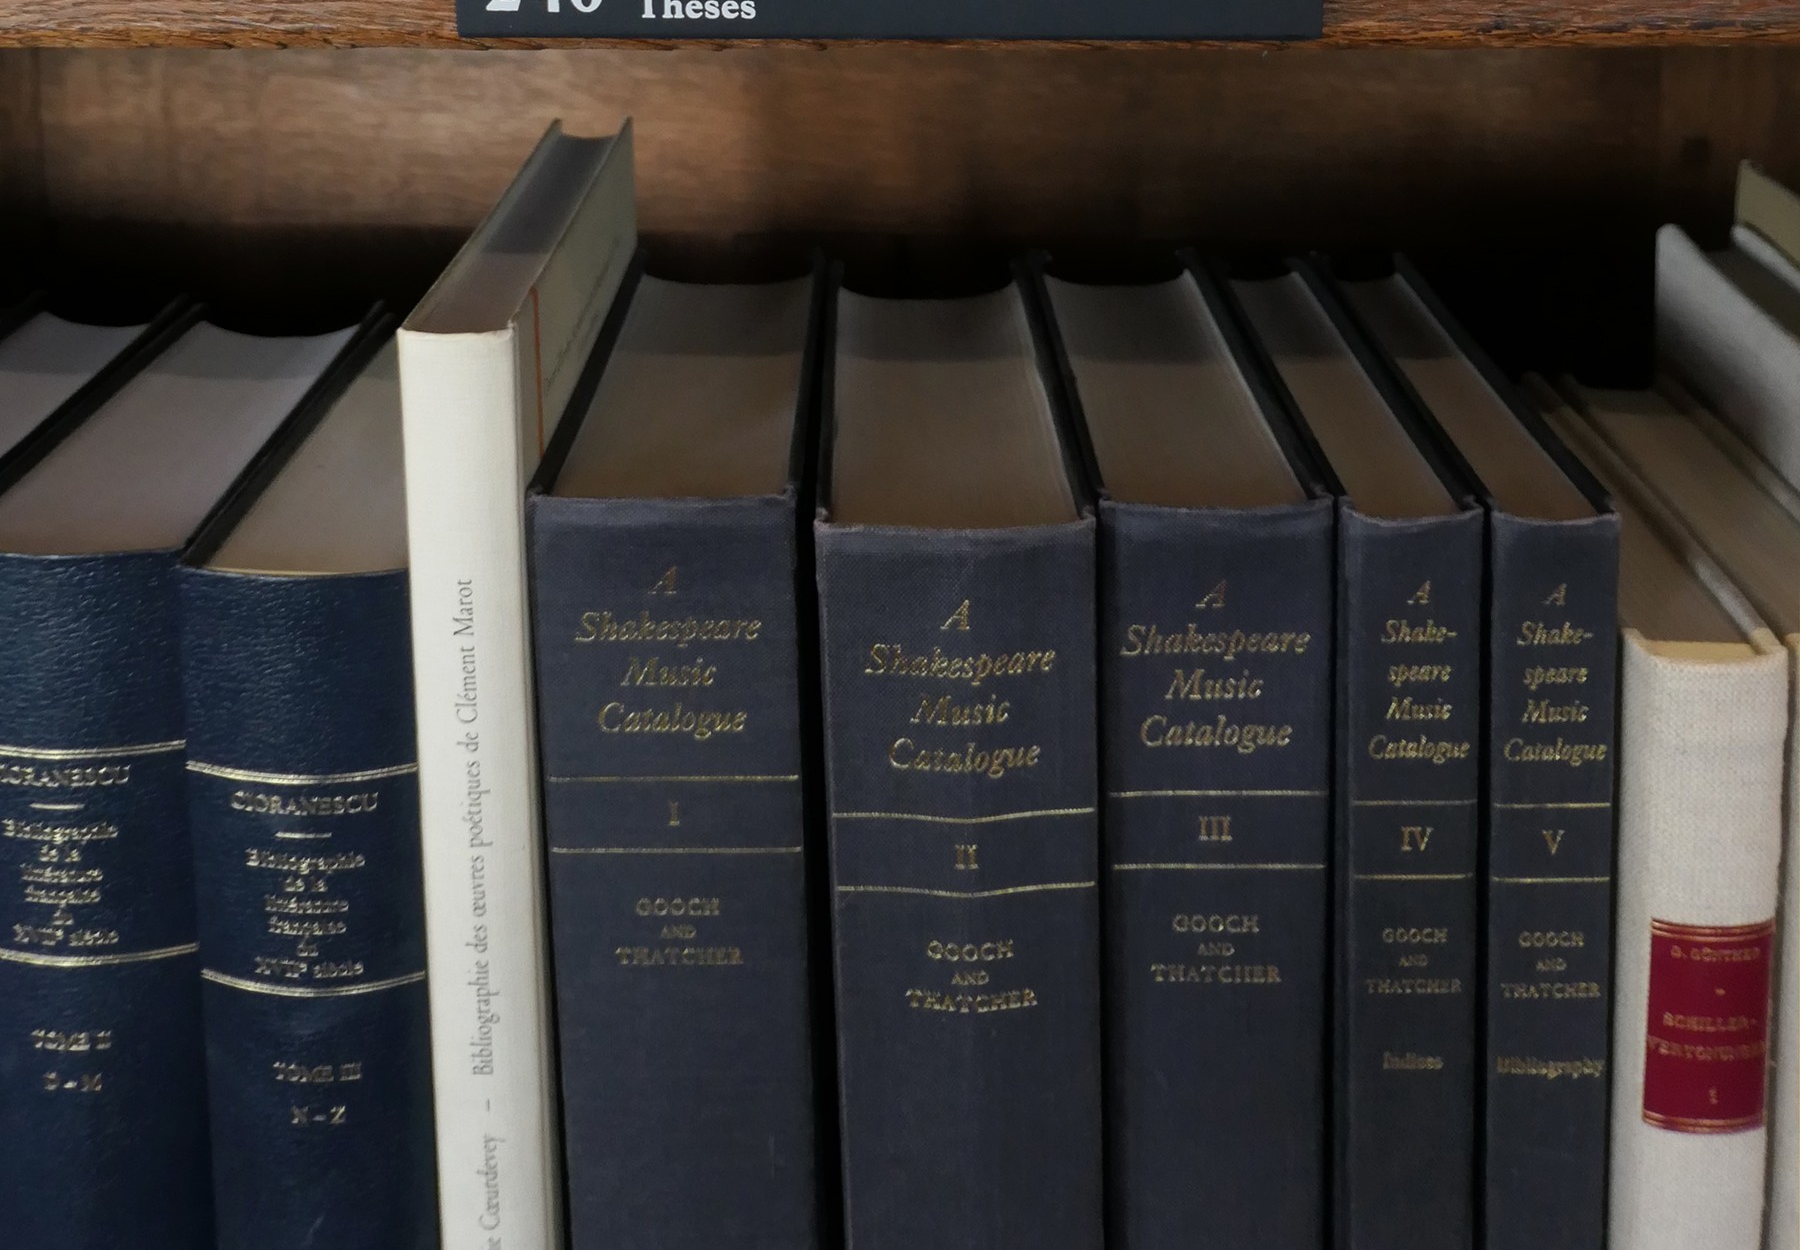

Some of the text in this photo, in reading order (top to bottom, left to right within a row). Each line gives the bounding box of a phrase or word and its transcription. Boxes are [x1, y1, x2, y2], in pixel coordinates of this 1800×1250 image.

[648, 565, 678, 596] A
[1195, 579, 1228, 608] A
[1406, 579, 1432, 605] A
[1542, 582, 1568, 607] A
[452, 578, 475, 638] Marot
[940, 599, 971, 630] A
[575, 611, 763, 648] Shakespeare
[1120, 623, 1312, 661] Shakespeare
[620, 655, 718, 687] Music
[864, 643, 1057, 685] Shakespeare
[455, 645, 479, 726] Clément
[1164, 668, 1265, 701] Music
[599, 701, 748, 740] Catalogue
[909, 693, 1011, 727] Music
[1384, 696, 1453, 722] Music
[1521, 699, 1591, 725] Music
[456, 731, 481, 753] de
[1140, 713, 1294, 754] Catalogue
[1367, 733, 1472, 765] Catalogue
[888, 737, 1041, 779] Catalogue
[1503, 736, 1609, 768] Catalogue
[460, 760, 495, 849] poétiques
[668, 801, 681, 827] I
[1198, 814, 1233, 842] III
[1400, 825, 1435, 852] IV
[1541, 829, 1566, 855] V
[953, 844, 979, 871] II
[464, 923, 489, 954] des
[1151, 962, 1283, 984] THATCHER
[466, 958, 501, 1077] Bibliographie
